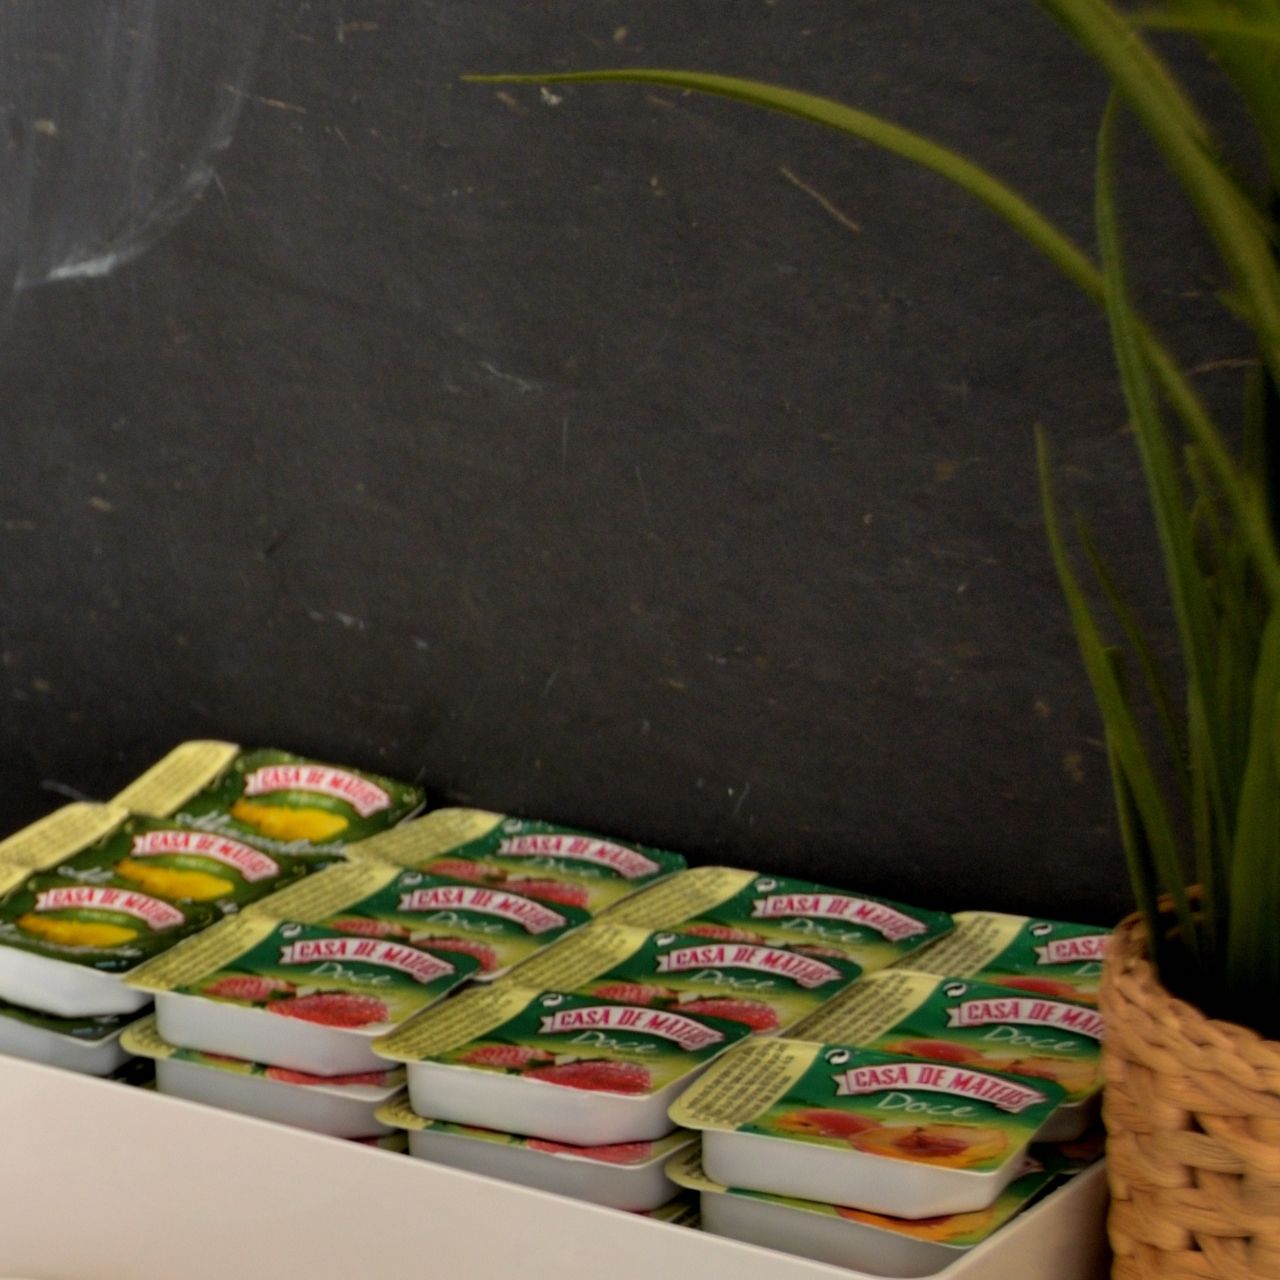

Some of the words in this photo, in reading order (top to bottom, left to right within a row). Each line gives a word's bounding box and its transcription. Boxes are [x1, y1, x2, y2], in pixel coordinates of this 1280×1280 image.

[261, 768, 300, 786] CASA
[150, 833, 190, 849] CASA
[517, 837, 562, 850] CASA
[418, 890, 464, 906] CASA
[770, 897, 819, 914] CASA
[825, 899, 851, 916] DE
[855, 903, 916, 936] MATEUS
[299, 941, 346, 958] CASA
[675, 948, 727, 966] CASA
[734, 948, 757, 966] DE
[761, 951, 834, 988] MATEUS
[690, 970, 778, 991] Doce
[966, 1001, 1020, 1020] CASA
[1028, 1001, 1055, 1022] DE
[560, 1008, 612, 1028] CASA
[618, 1010, 640, 1028] DE
[644, 1012, 717, 1049] MATEUS
[984, 1026, 1081, 1051] Doce
[570, 1031, 657, 1053] Doce
[853, 1065, 908, 1088] CASA
[915, 1066, 944, 1088] DE
[949, 1071, 1034, 1111] MATEUS
[877, 1092, 980, 1117] Doce
